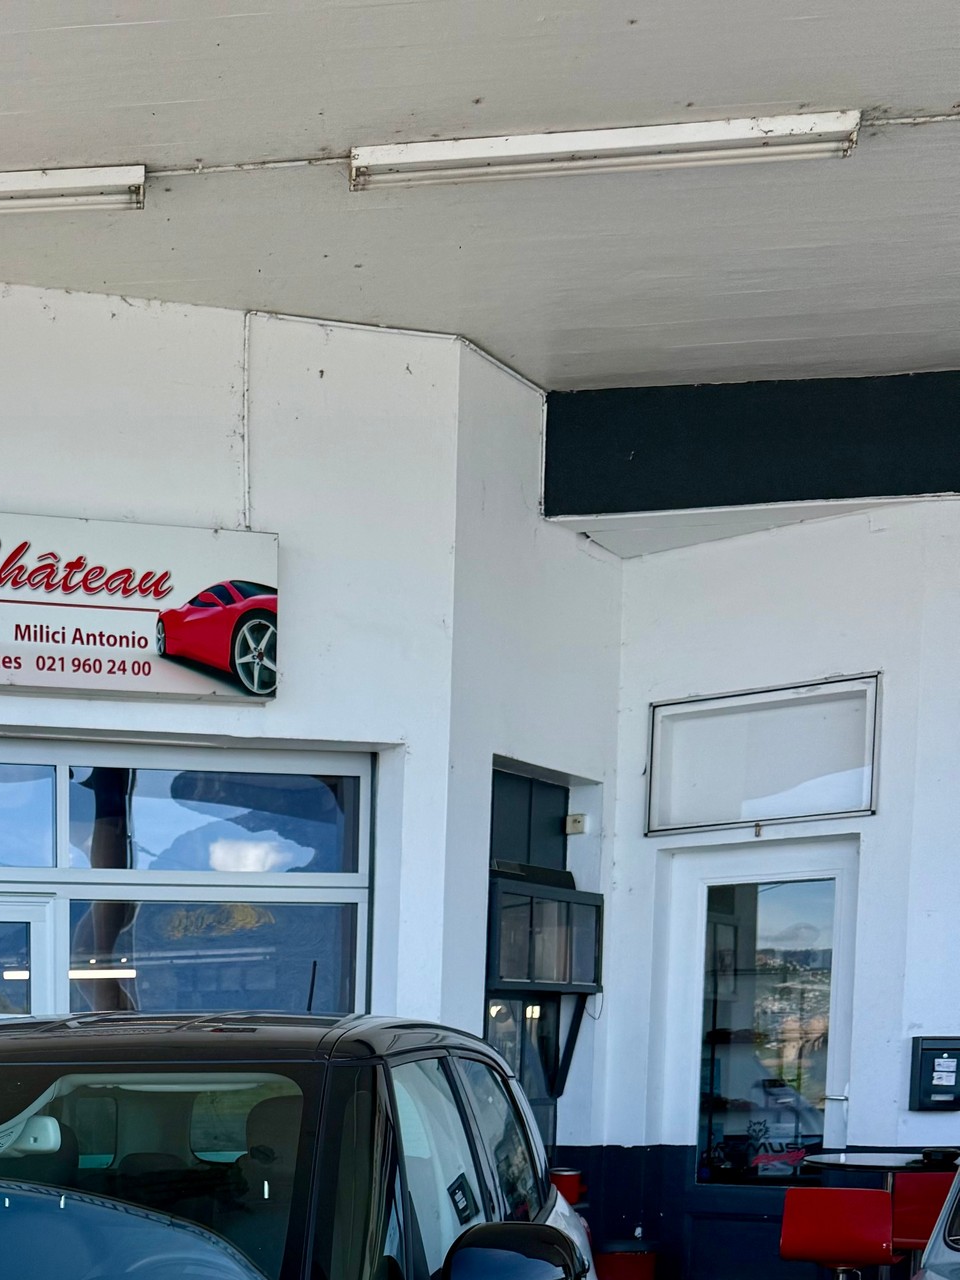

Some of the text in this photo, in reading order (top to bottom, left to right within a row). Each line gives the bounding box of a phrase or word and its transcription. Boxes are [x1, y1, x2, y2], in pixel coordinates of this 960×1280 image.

[14, 623, 149, 649] Milici Antonio
[35, 655, 152, 677] 021 960 24 00
